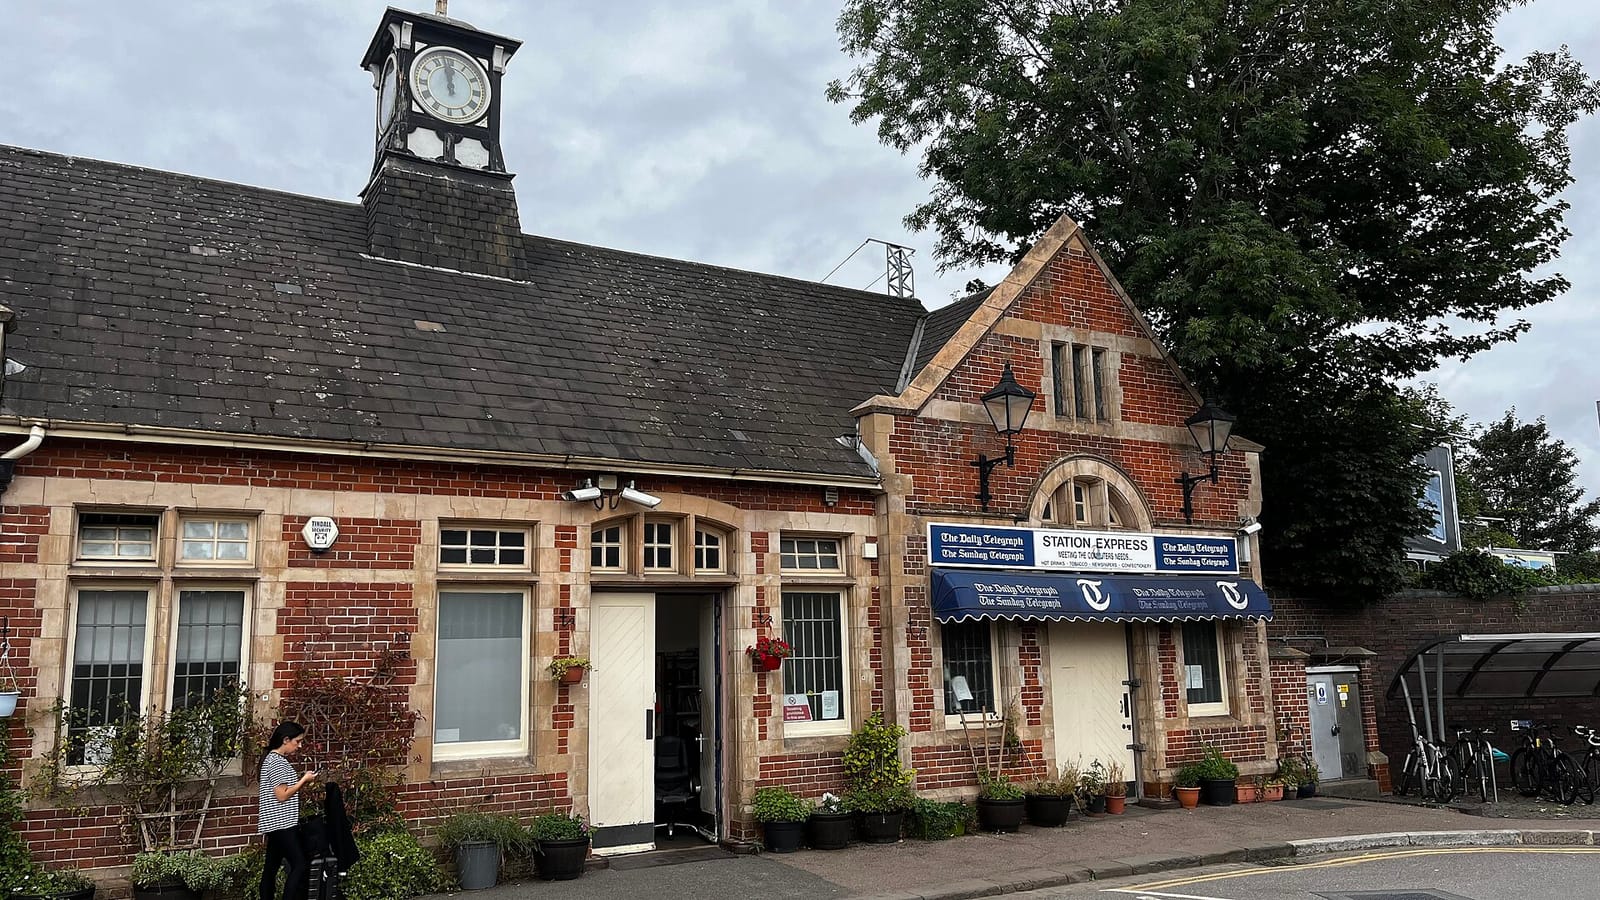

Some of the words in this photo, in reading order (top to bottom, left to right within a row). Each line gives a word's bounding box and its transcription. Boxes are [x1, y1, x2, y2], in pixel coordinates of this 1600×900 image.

[940, 532, 958, 543] The
[959, 533, 982, 546] Daily
[983, 534, 1023, 547] Telegraph
[1042, 535, 1091, 549] STATION
[1096, 538, 1148, 551] EXPRESS
[1162, 543, 1177, 552] The
[1178, 543, 1196, 554] Daily
[1196, 543, 1228, 554] Telegraph
[941, 549, 957, 558] The
[958, 549, 988, 560] Sunday
[989, 551, 1025, 562] Telegraph
[1078, 552, 1087, 560] THE
[1177, 557, 1201, 567] Sunday
[1201, 558, 1229, 567] Telegraph
[974, 583, 992, 593] The
[993, 584, 1017, 595] Daily
[1016, 585, 1058, 596] Telegraph
[979, 596, 995, 606] The
[996, 596, 1026, 608] Sunday
[1026, 597, 1061, 609] Telegraph
